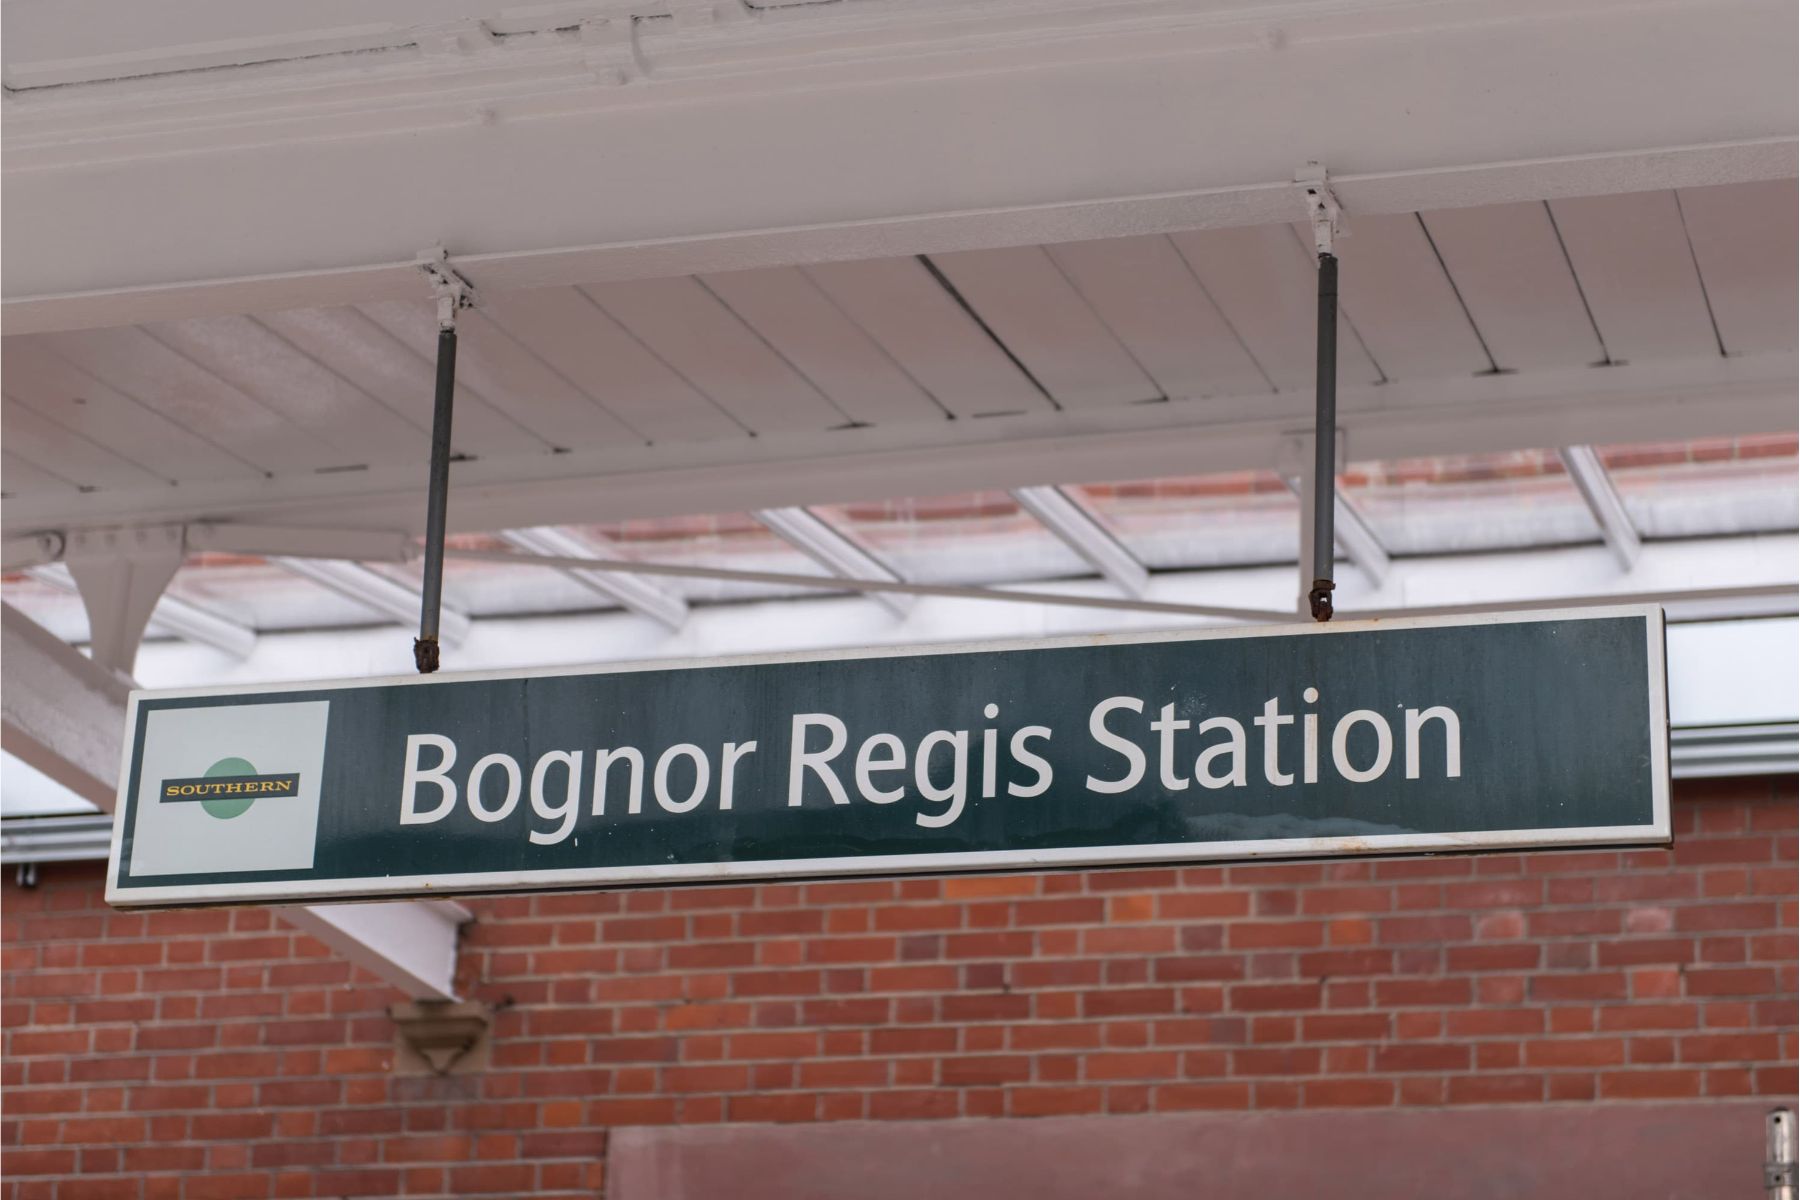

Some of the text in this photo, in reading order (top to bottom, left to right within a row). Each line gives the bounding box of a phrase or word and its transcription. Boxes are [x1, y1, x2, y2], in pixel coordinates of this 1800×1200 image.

[166, 780, 292, 796] SOUTHERN
[399, 687, 1461, 845] Bognor Regis Station
